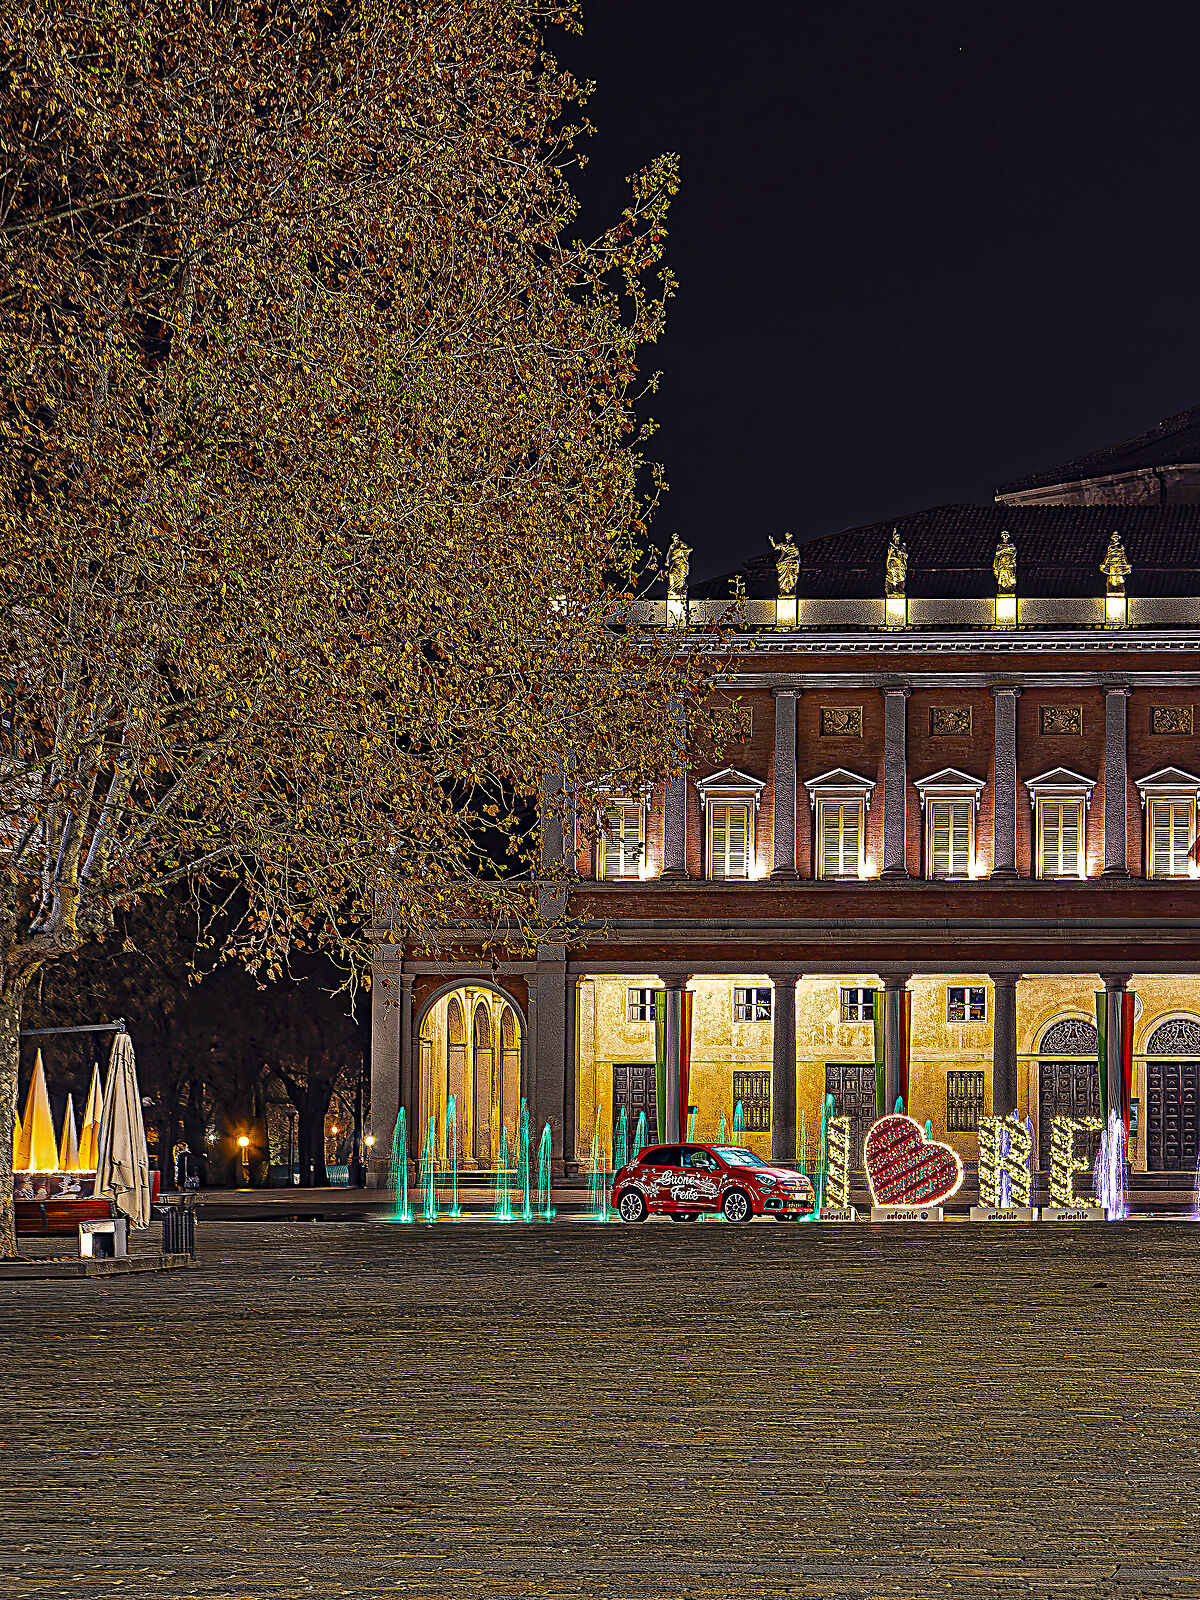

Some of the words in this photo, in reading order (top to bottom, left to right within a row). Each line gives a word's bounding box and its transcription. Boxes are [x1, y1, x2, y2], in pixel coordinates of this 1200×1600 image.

[977, 1115, 1105, 1209] RE
[659, 1169, 697, 1186] Buone
[671, 1184, 699, 1201] Feste
